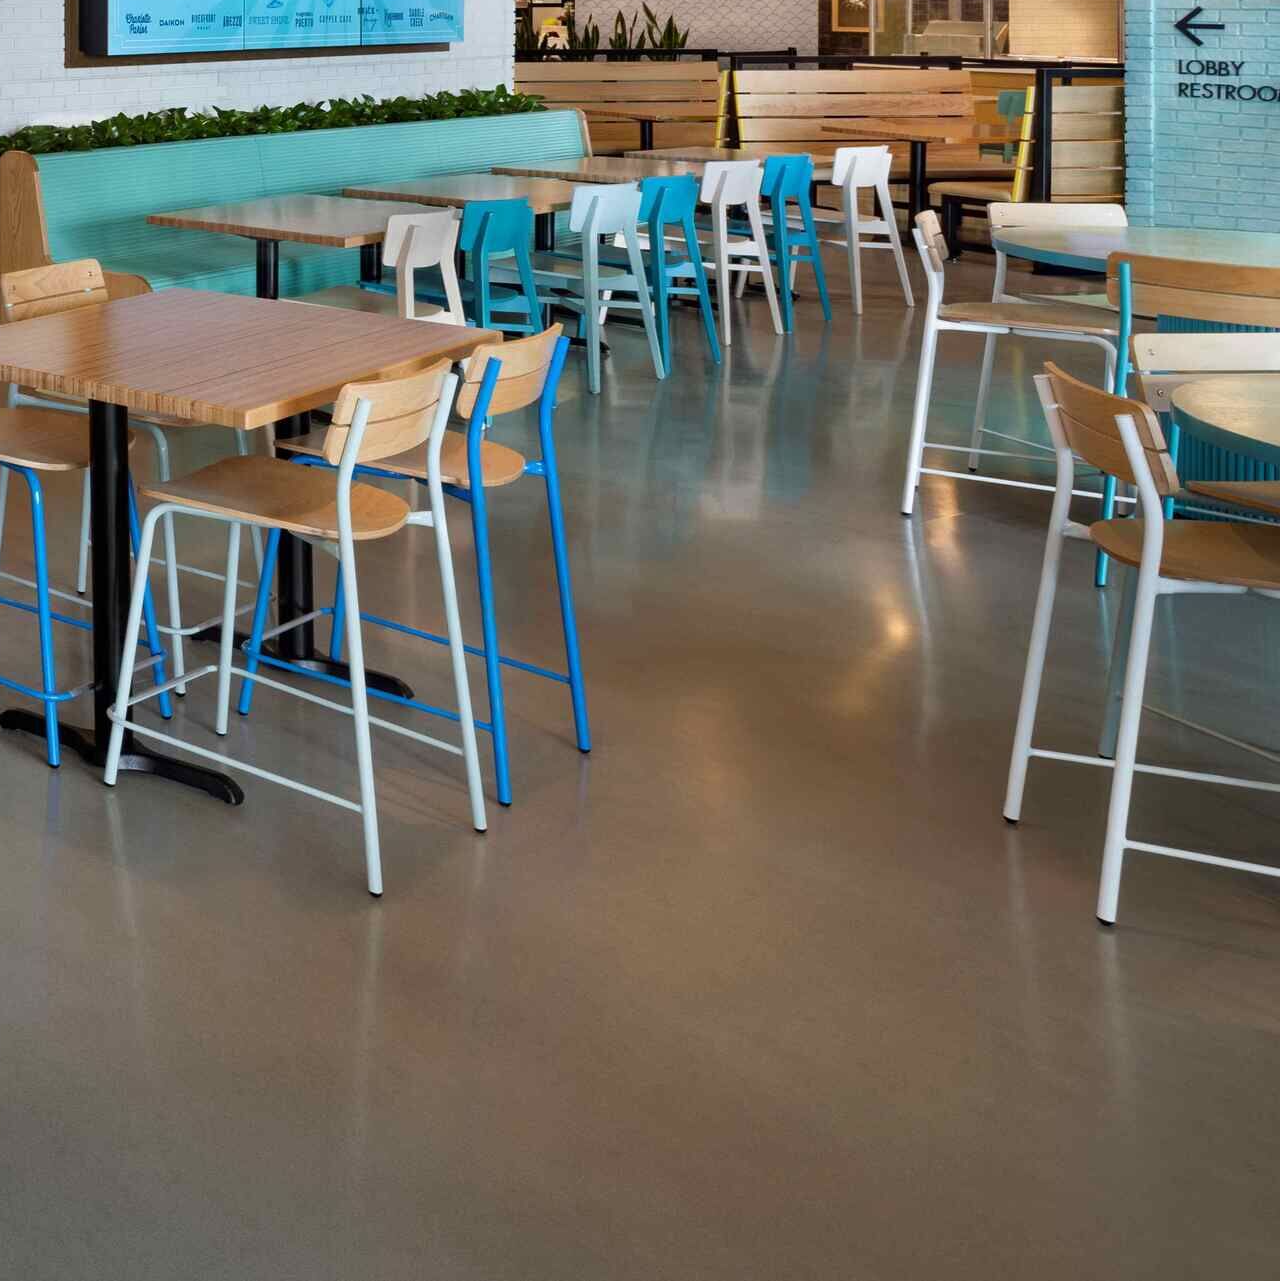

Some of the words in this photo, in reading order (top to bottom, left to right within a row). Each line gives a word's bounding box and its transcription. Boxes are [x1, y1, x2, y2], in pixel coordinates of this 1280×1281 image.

[159, 19, 185, 27] DAIKON
[1178, 59, 1245, 77] LOBBY
[1178, 82, 1280, 102] RESTROO
